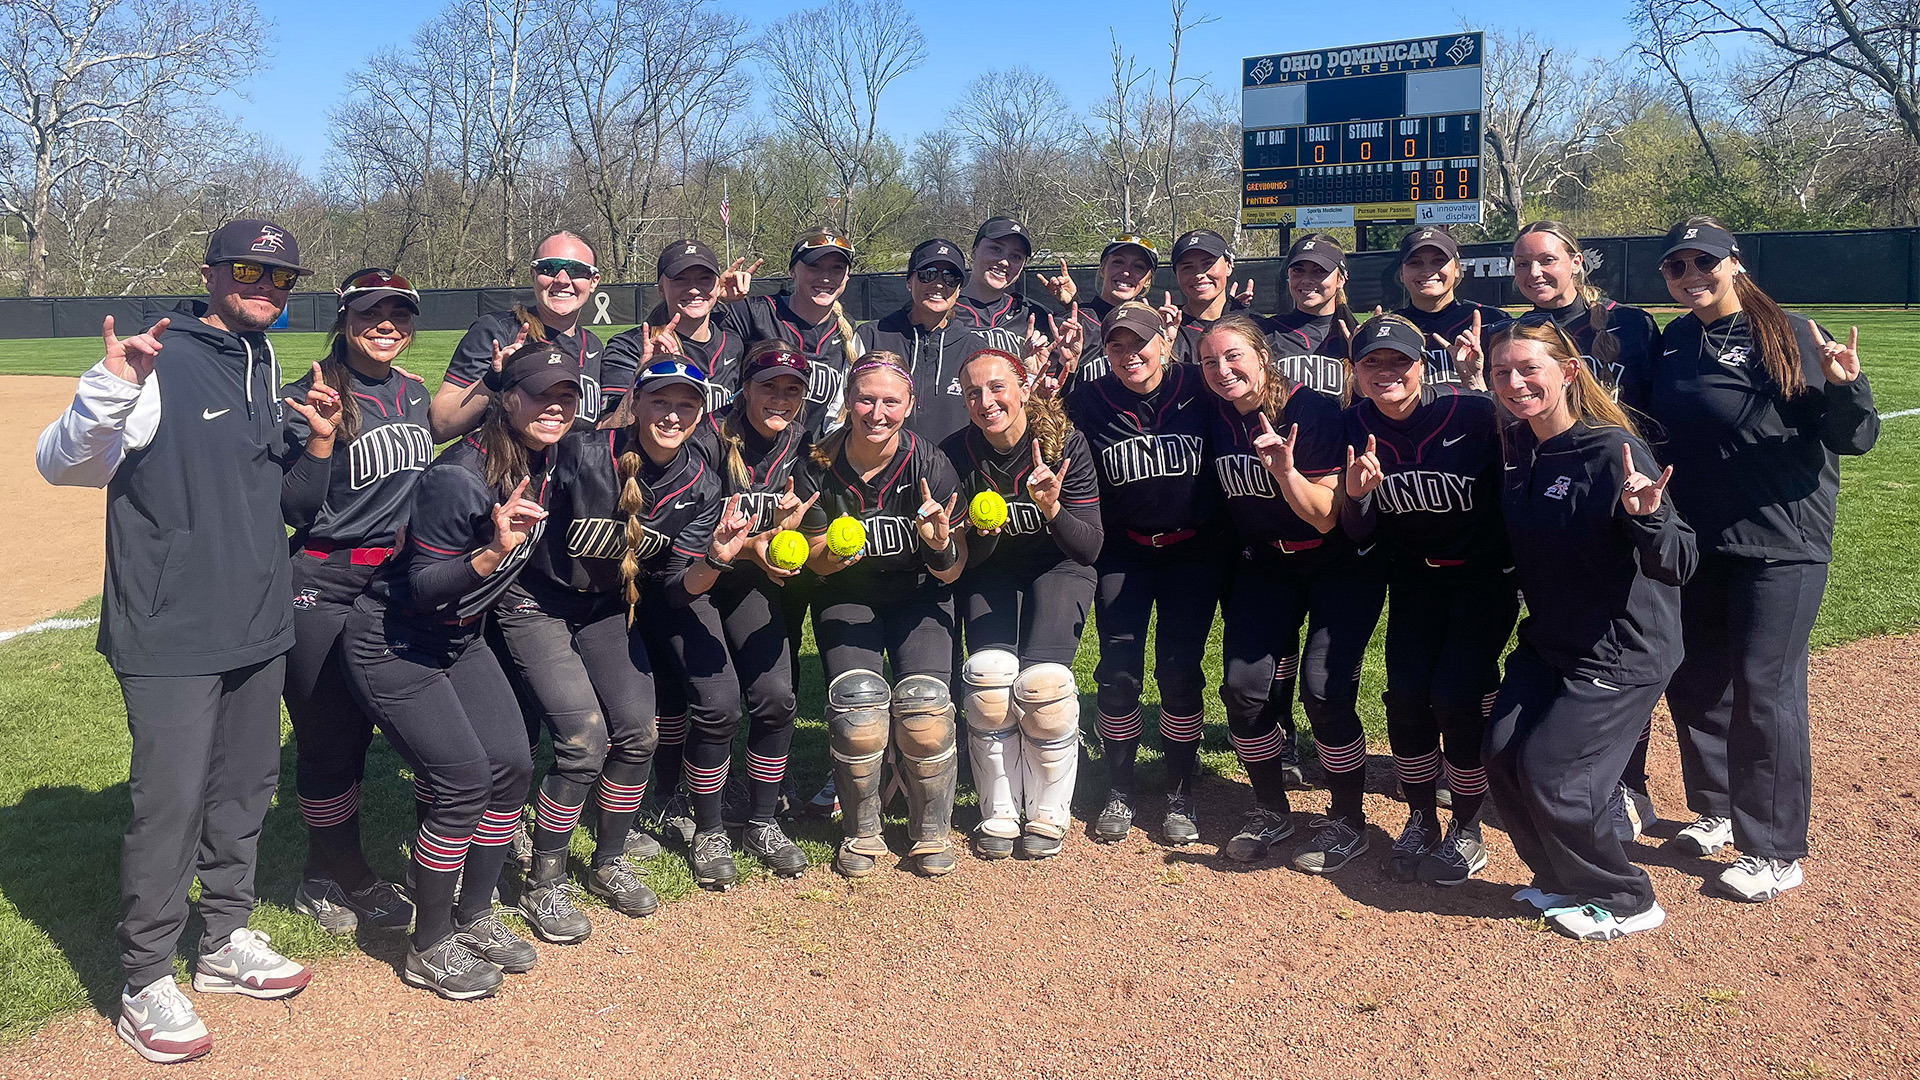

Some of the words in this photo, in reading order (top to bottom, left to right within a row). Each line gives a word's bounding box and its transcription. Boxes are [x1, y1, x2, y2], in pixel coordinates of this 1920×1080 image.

[1280, 53, 1322, 73] OHIO
[1327, 41, 1439, 69] DOMINICAN
[1280, 58, 1437, 82] UNIVERSITY
[1309, 126, 1330, 142] BALL
[1349, 122, 1383, 139] STRIKE
[1400, 119, 1420, 136] OUT
[1256, 131, 1266, 146] AT
[1269, 130, 1284, 145] BAT
[1314, 145, 1324, 163] 0
[1361, 141, 1371, 160] 0
[1404, 138, 1415, 158] 0
[1246, 181, 1288, 191] GREYHOUNDS
[1411, 171, 1419, 185] 0
[1435, 170, 1444, 184] 0
[1459, 169, 1467, 183] 0
[1246, 196, 1279, 205] PANTHERS
[1411, 187, 1419, 200] 0
[1435, 185, 1444, 200] 0
[1459, 184, 1467, 198] 0
[1421, 207, 1433, 220] id
[1445, 212, 1477, 221] displays
[1102, 433, 1203, 487] UINDY
